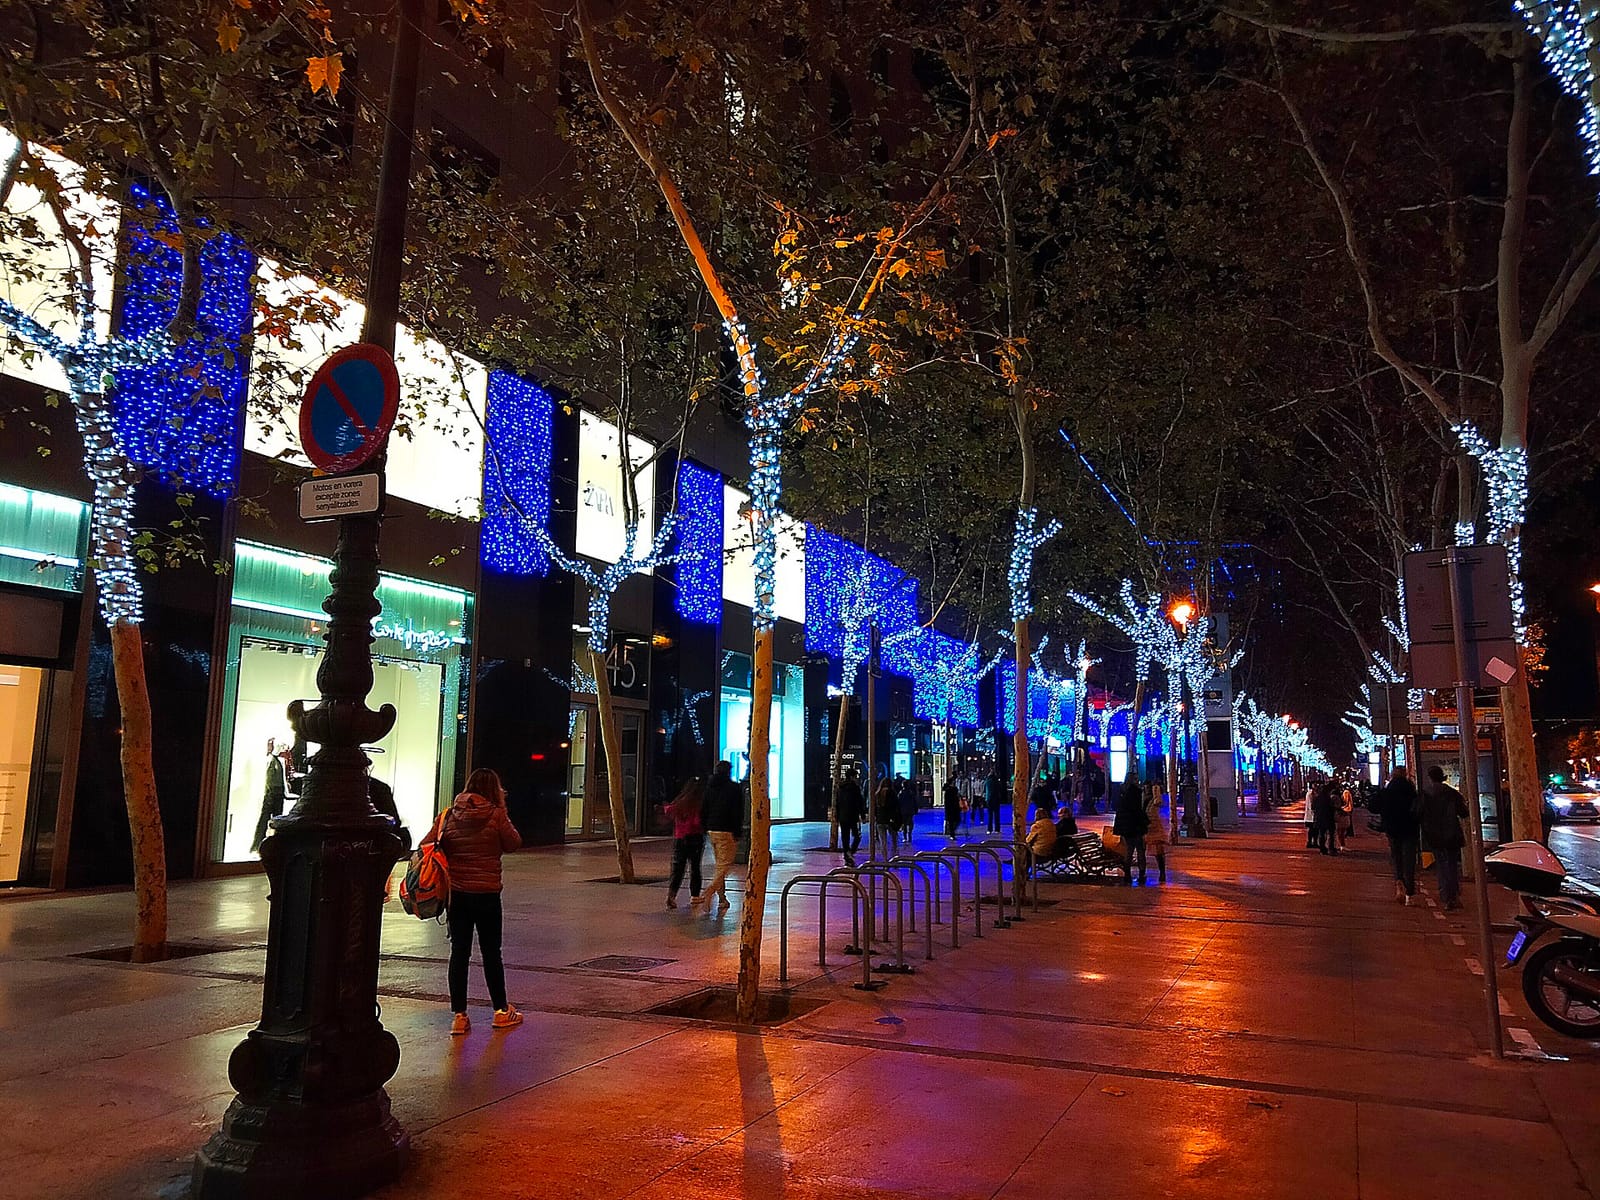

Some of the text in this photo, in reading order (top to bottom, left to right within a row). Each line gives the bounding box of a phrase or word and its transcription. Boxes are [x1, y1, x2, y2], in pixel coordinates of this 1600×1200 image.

[312, 484, 333, 492] Motos
[343, 480, 363, 488] vorera
[315, 490, 361, 502] excepte zones
[315, 500, 359, 511] senyalitzades
